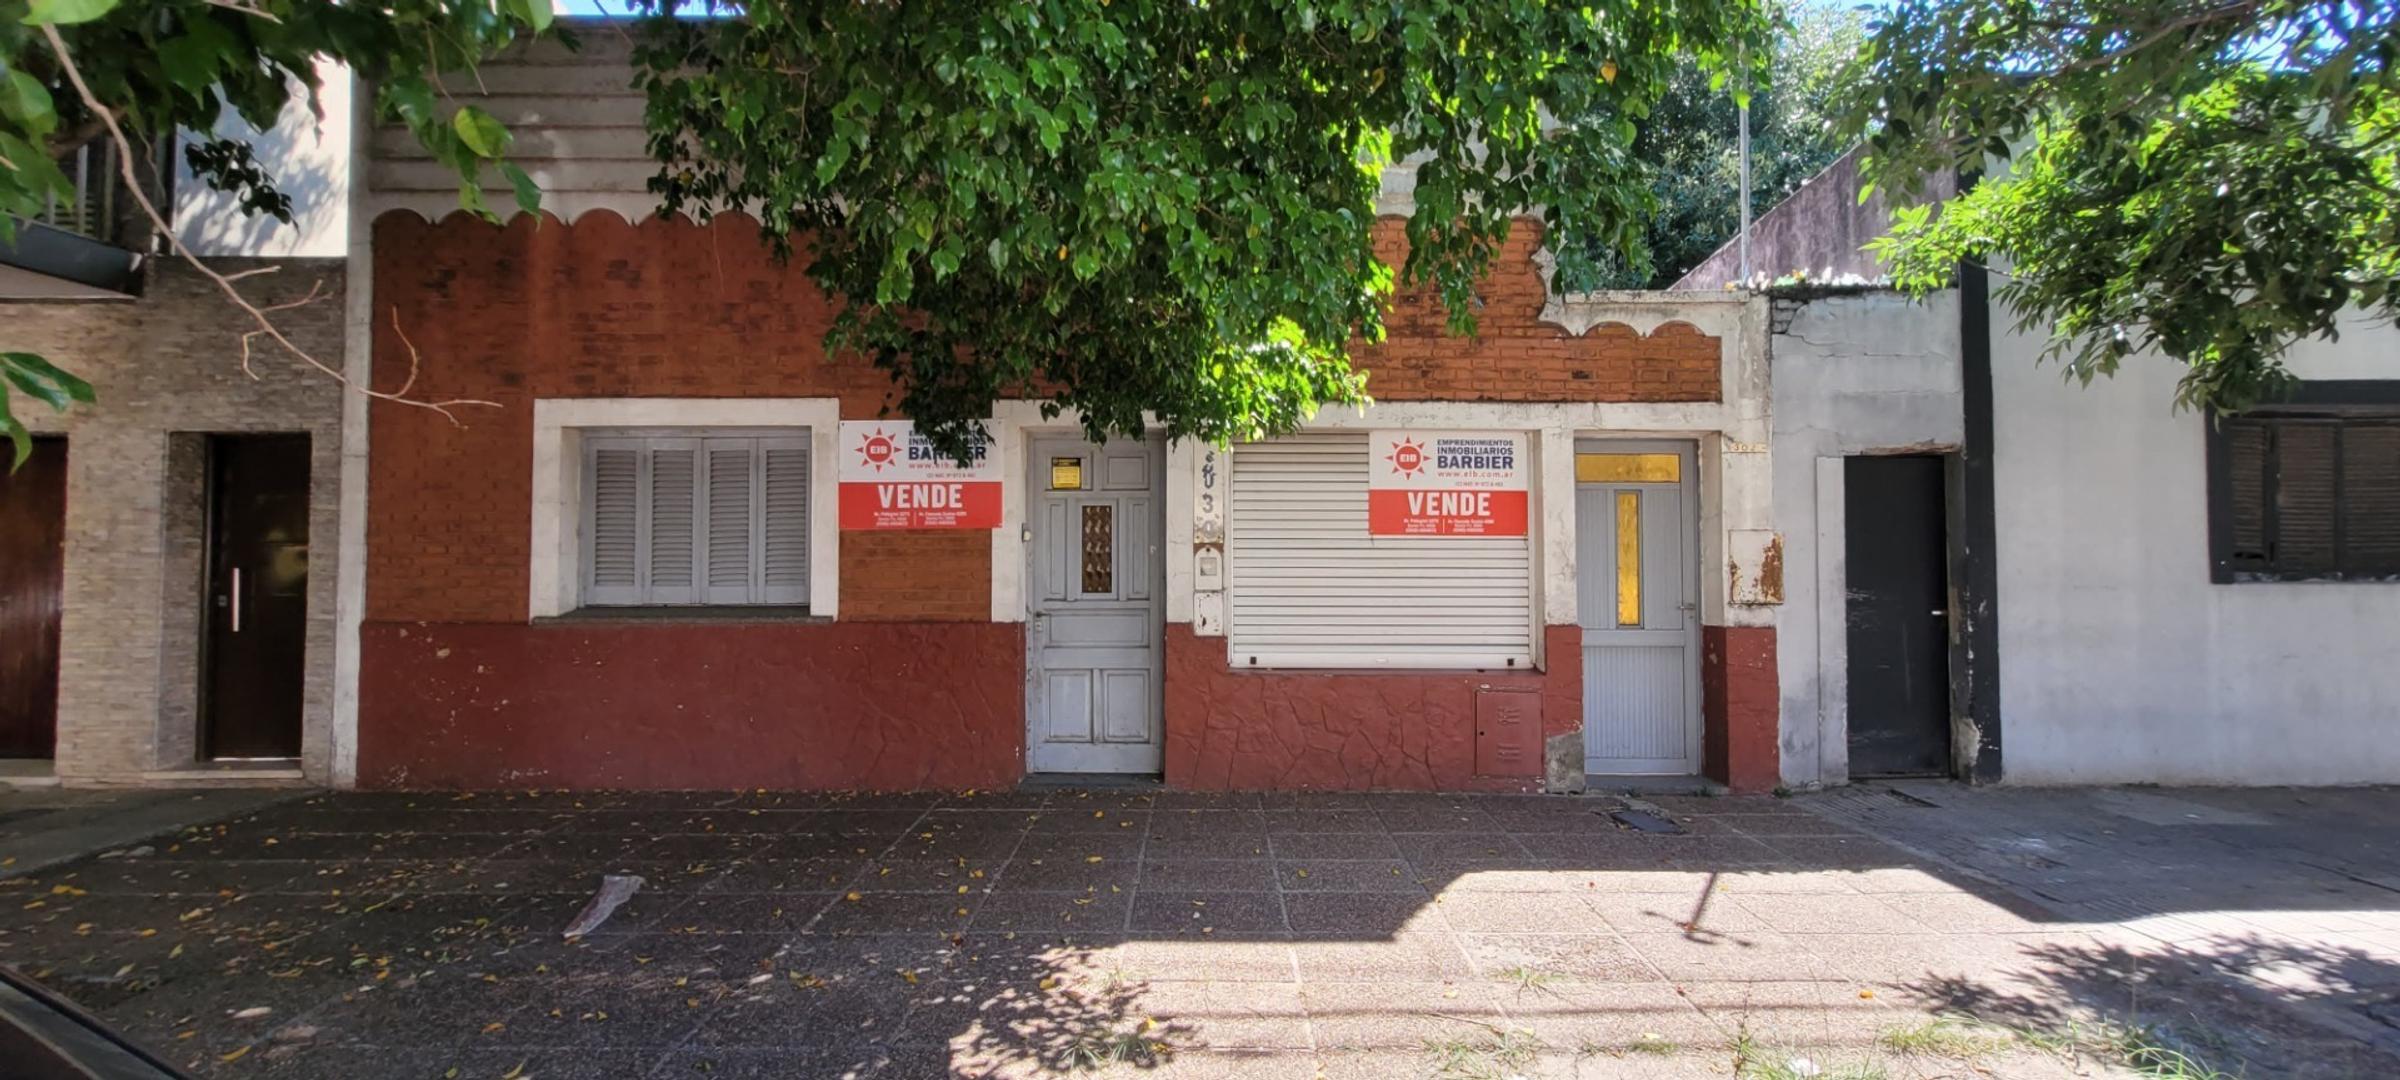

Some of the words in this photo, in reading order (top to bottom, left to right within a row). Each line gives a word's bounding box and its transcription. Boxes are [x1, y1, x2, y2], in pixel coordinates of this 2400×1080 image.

[909, 447, 986, 460] BARBER
[1437, 447, 1514, 455] INMOBILIARIOS
[1437, 456, 1513, 469] BARBIER
[878, 484, 963, 509] VENDE
[1407, 492, 1491, 516] VENDE
